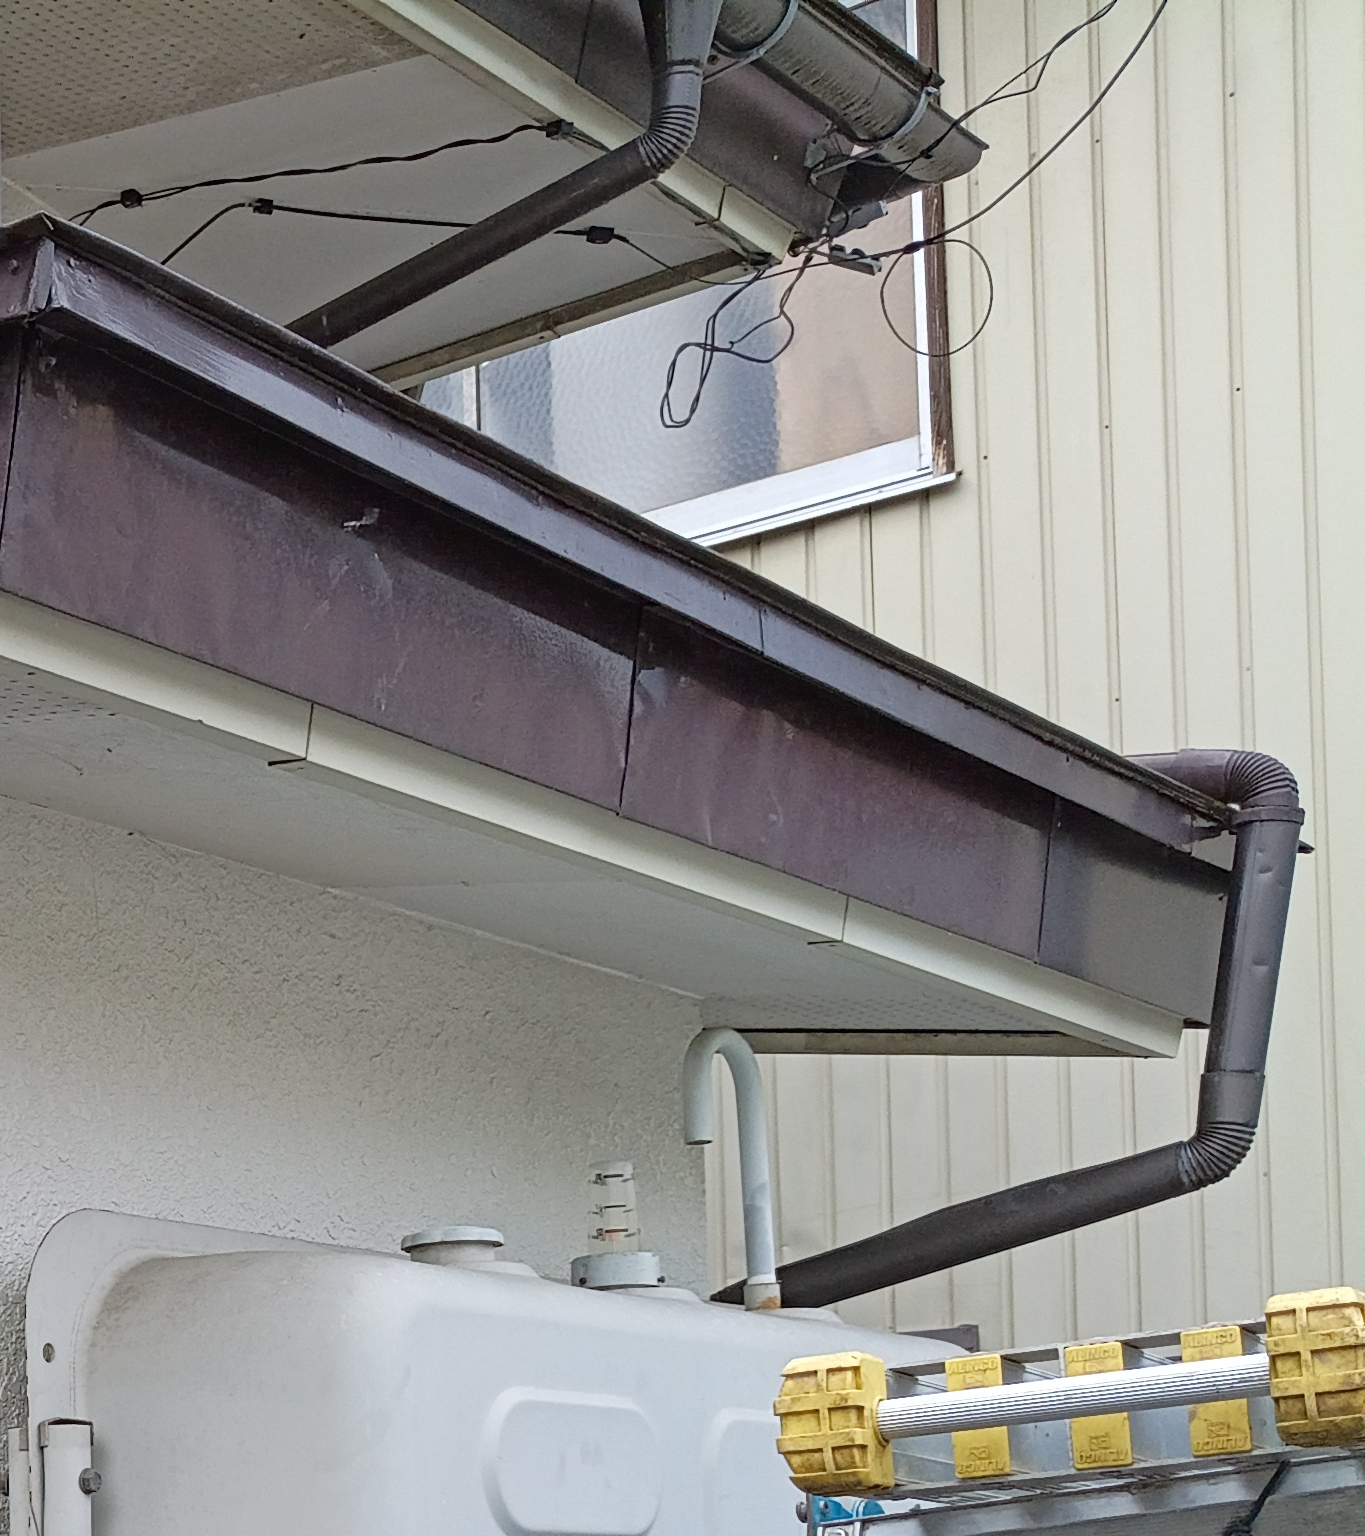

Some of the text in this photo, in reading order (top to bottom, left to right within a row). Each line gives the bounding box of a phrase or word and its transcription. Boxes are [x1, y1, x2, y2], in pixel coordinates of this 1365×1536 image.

[1069, 1346, 1118, 1363] ALINCO
[947, 1358, 998, 1375] ALINCO
[1077, 1448, 1129, 1465] ALINCO
